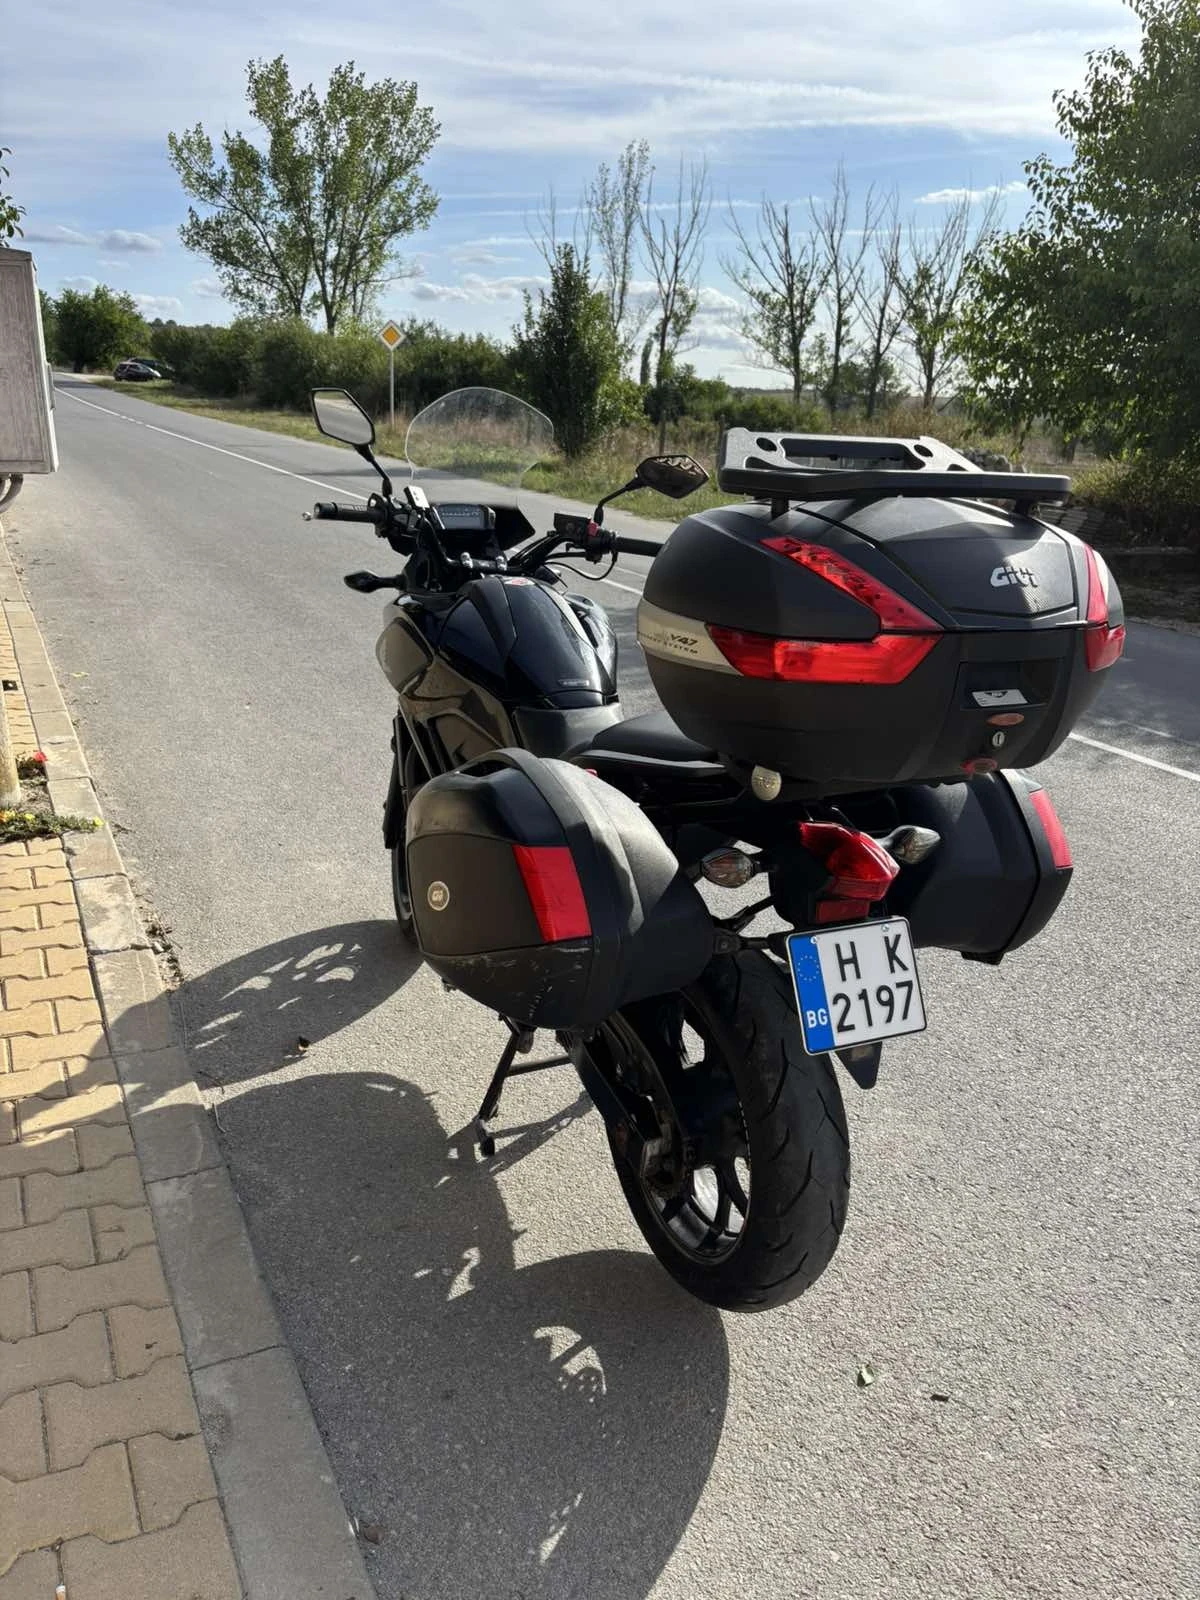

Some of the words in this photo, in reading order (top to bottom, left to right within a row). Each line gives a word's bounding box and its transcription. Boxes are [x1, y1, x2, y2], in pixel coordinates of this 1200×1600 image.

[835, 941, 861, 982] H
[884, 934, 909, 974] K
[806, 1008, 828, 1028] BG
[832, 980, 914, 1033] 2197
